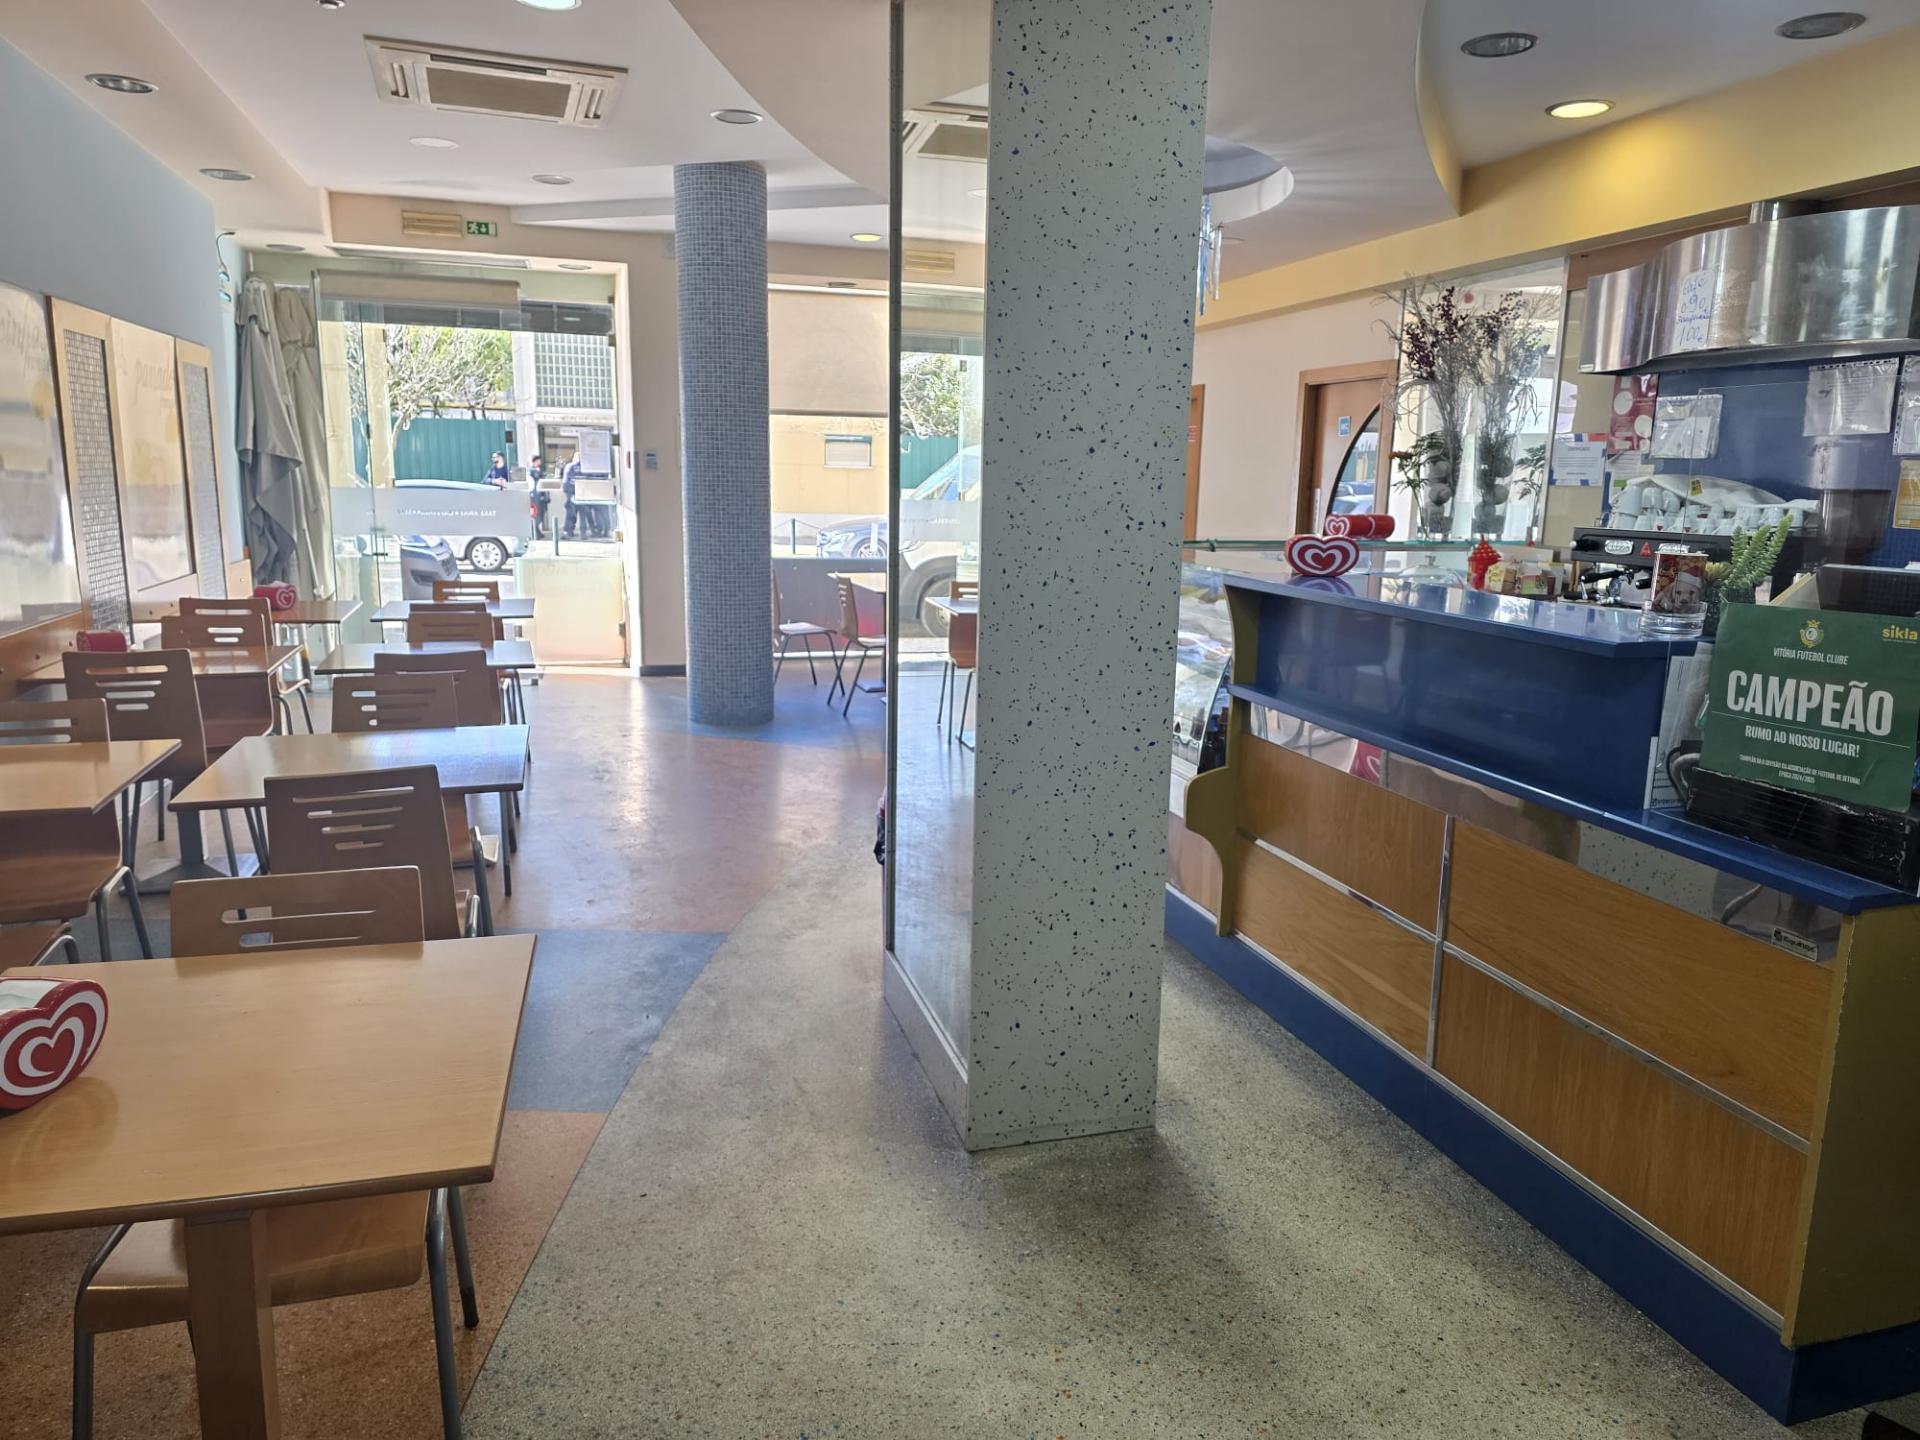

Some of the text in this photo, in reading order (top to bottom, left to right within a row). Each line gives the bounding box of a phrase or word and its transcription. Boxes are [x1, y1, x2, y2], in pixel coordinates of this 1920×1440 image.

[1773, 647, 1849, 665] VITÓRIA FUTEBOL CLUBE
[1726, 669, 1895, 737] CAMPEÃO
[1745, 725, 1860, 758] RUMO AO NOSSO LUGAR!
